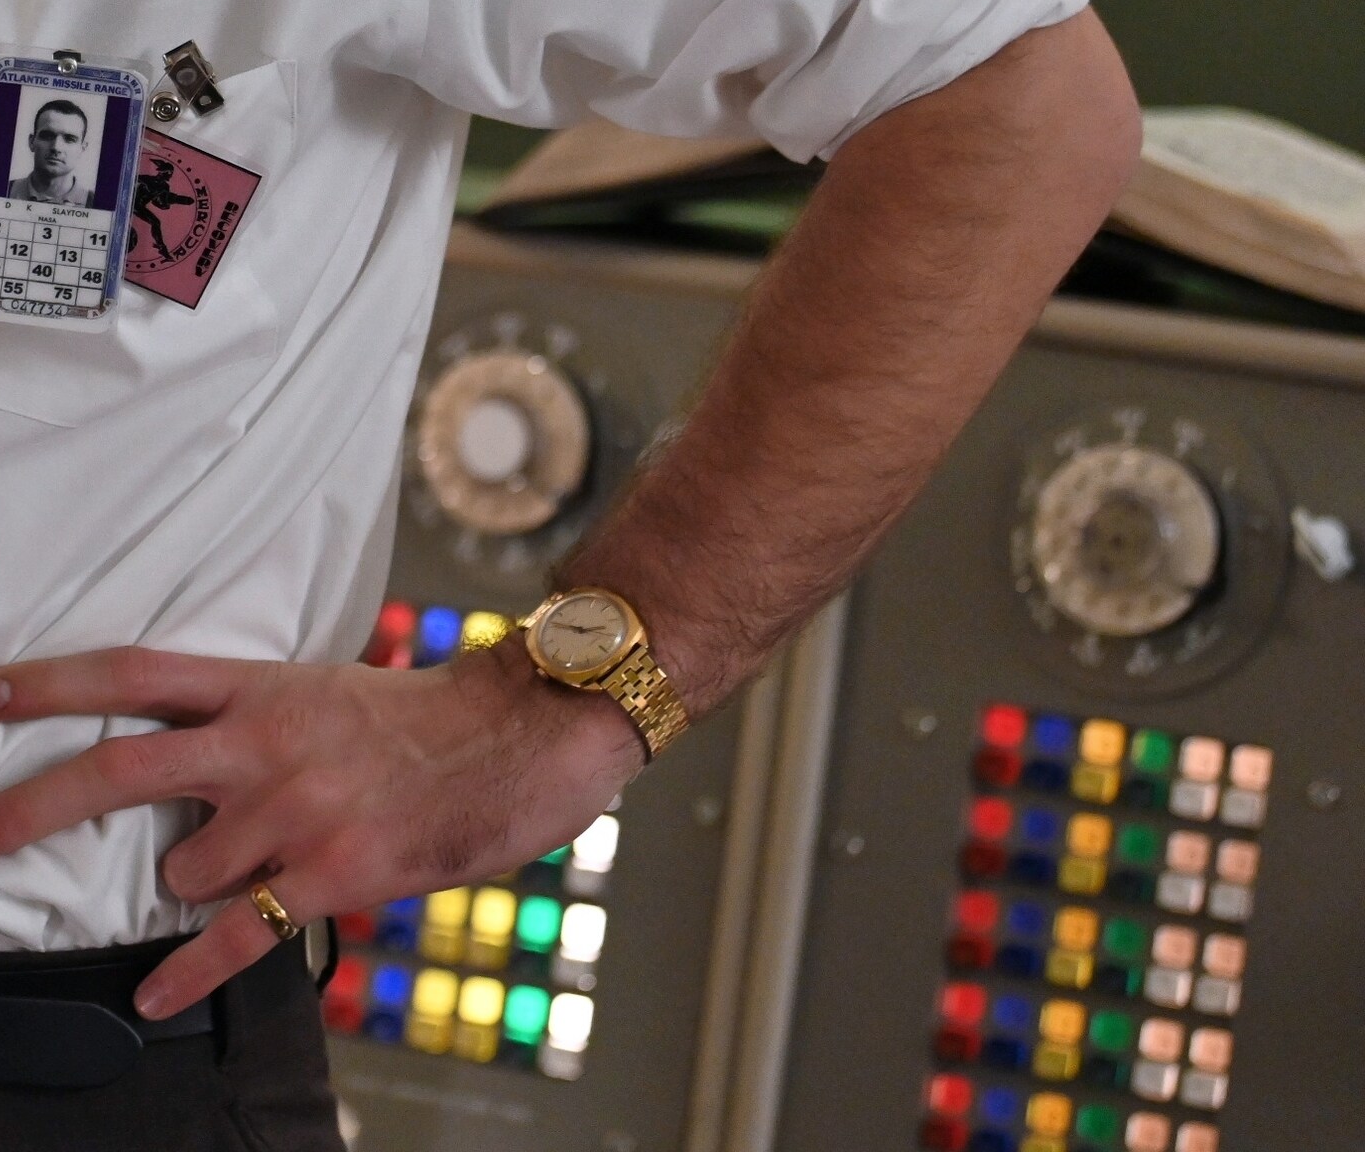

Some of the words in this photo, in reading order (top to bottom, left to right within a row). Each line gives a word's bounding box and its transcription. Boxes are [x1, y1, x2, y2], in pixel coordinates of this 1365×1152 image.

[0, 72, 49, 86] ATLANTIC
[52, 79, 90, 91] MISSILE
[94, 84, 129, 96] RANGE
[123, 75, 142, 95] AMR
[5, 201, 11, 209] D
[26, 204, 32, 212] K
[52, 207, 89, 219] SLAYTON
[38, 216, 57, 224] NASA
[42, 227, 52, 239] 3
[89, 233, 107, 246] 11
[10, 243, 29, 257] 12
[59, 249, 78, 263] 13
[32, 265, 53, 278] 40
[81, 270, 103, 284] 48
[3, 281, 24, 295] 55
[53, 287, 73, 300] 75
[91, 299, 112, 318] AR
